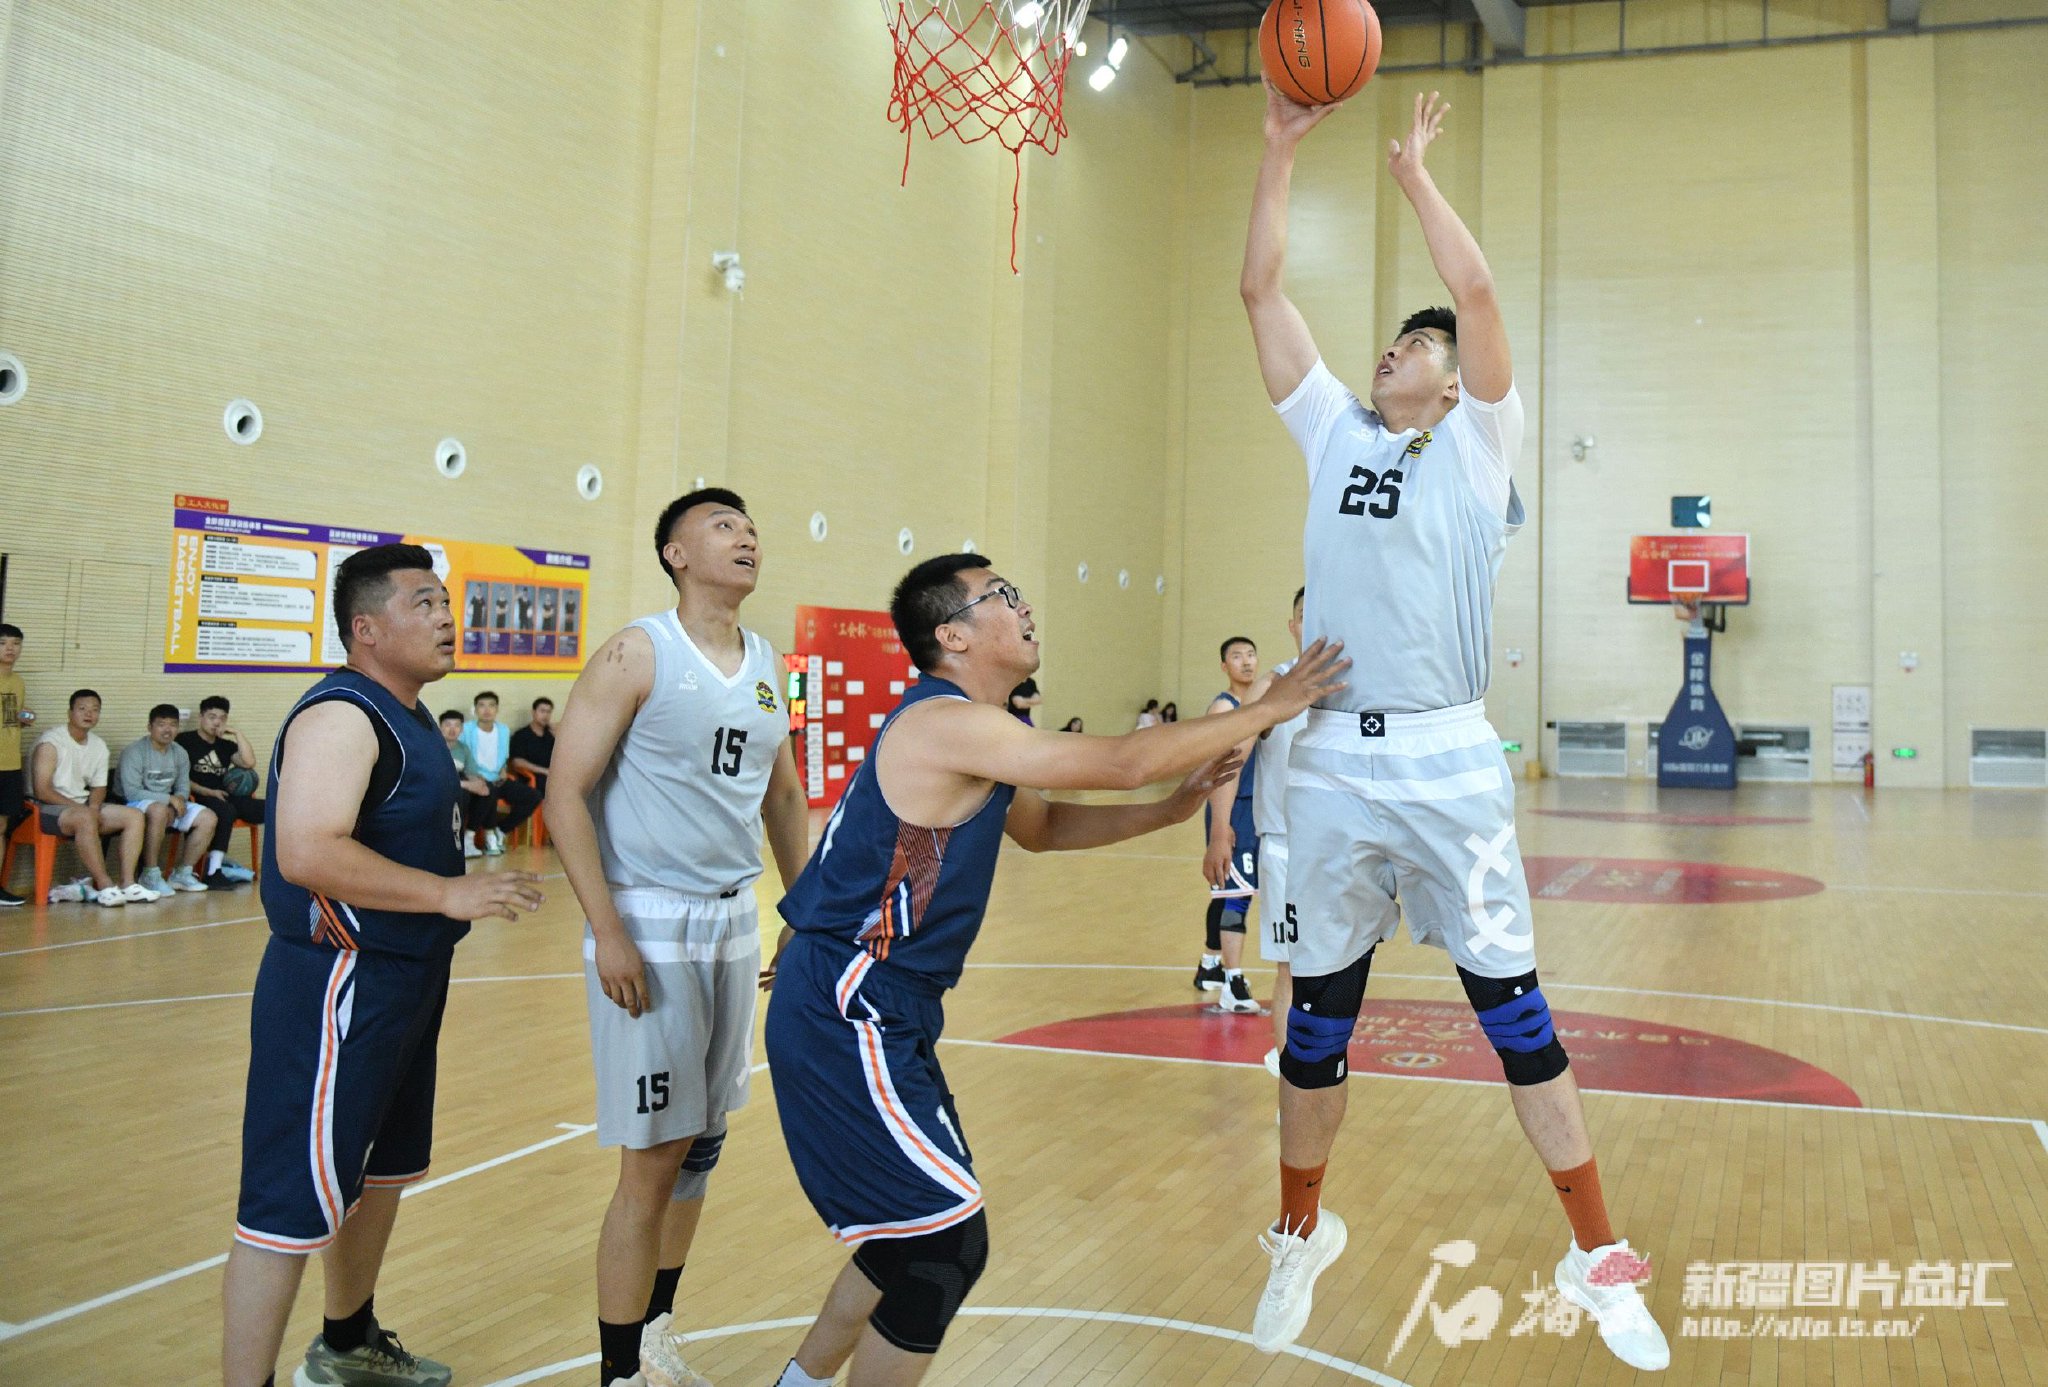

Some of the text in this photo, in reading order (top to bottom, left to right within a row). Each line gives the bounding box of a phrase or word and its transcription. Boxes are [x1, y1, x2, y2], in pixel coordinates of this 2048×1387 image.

[1339, 465, 1403, 519] 25
[187, 536, 199, 595] ENJOY
[170, 535, 188, 655] BASKETBALL
[711, 727, 748, 777] 15
[1242, 852, 1254, 875] 6
[637, 1072, 669, 1114] 15
